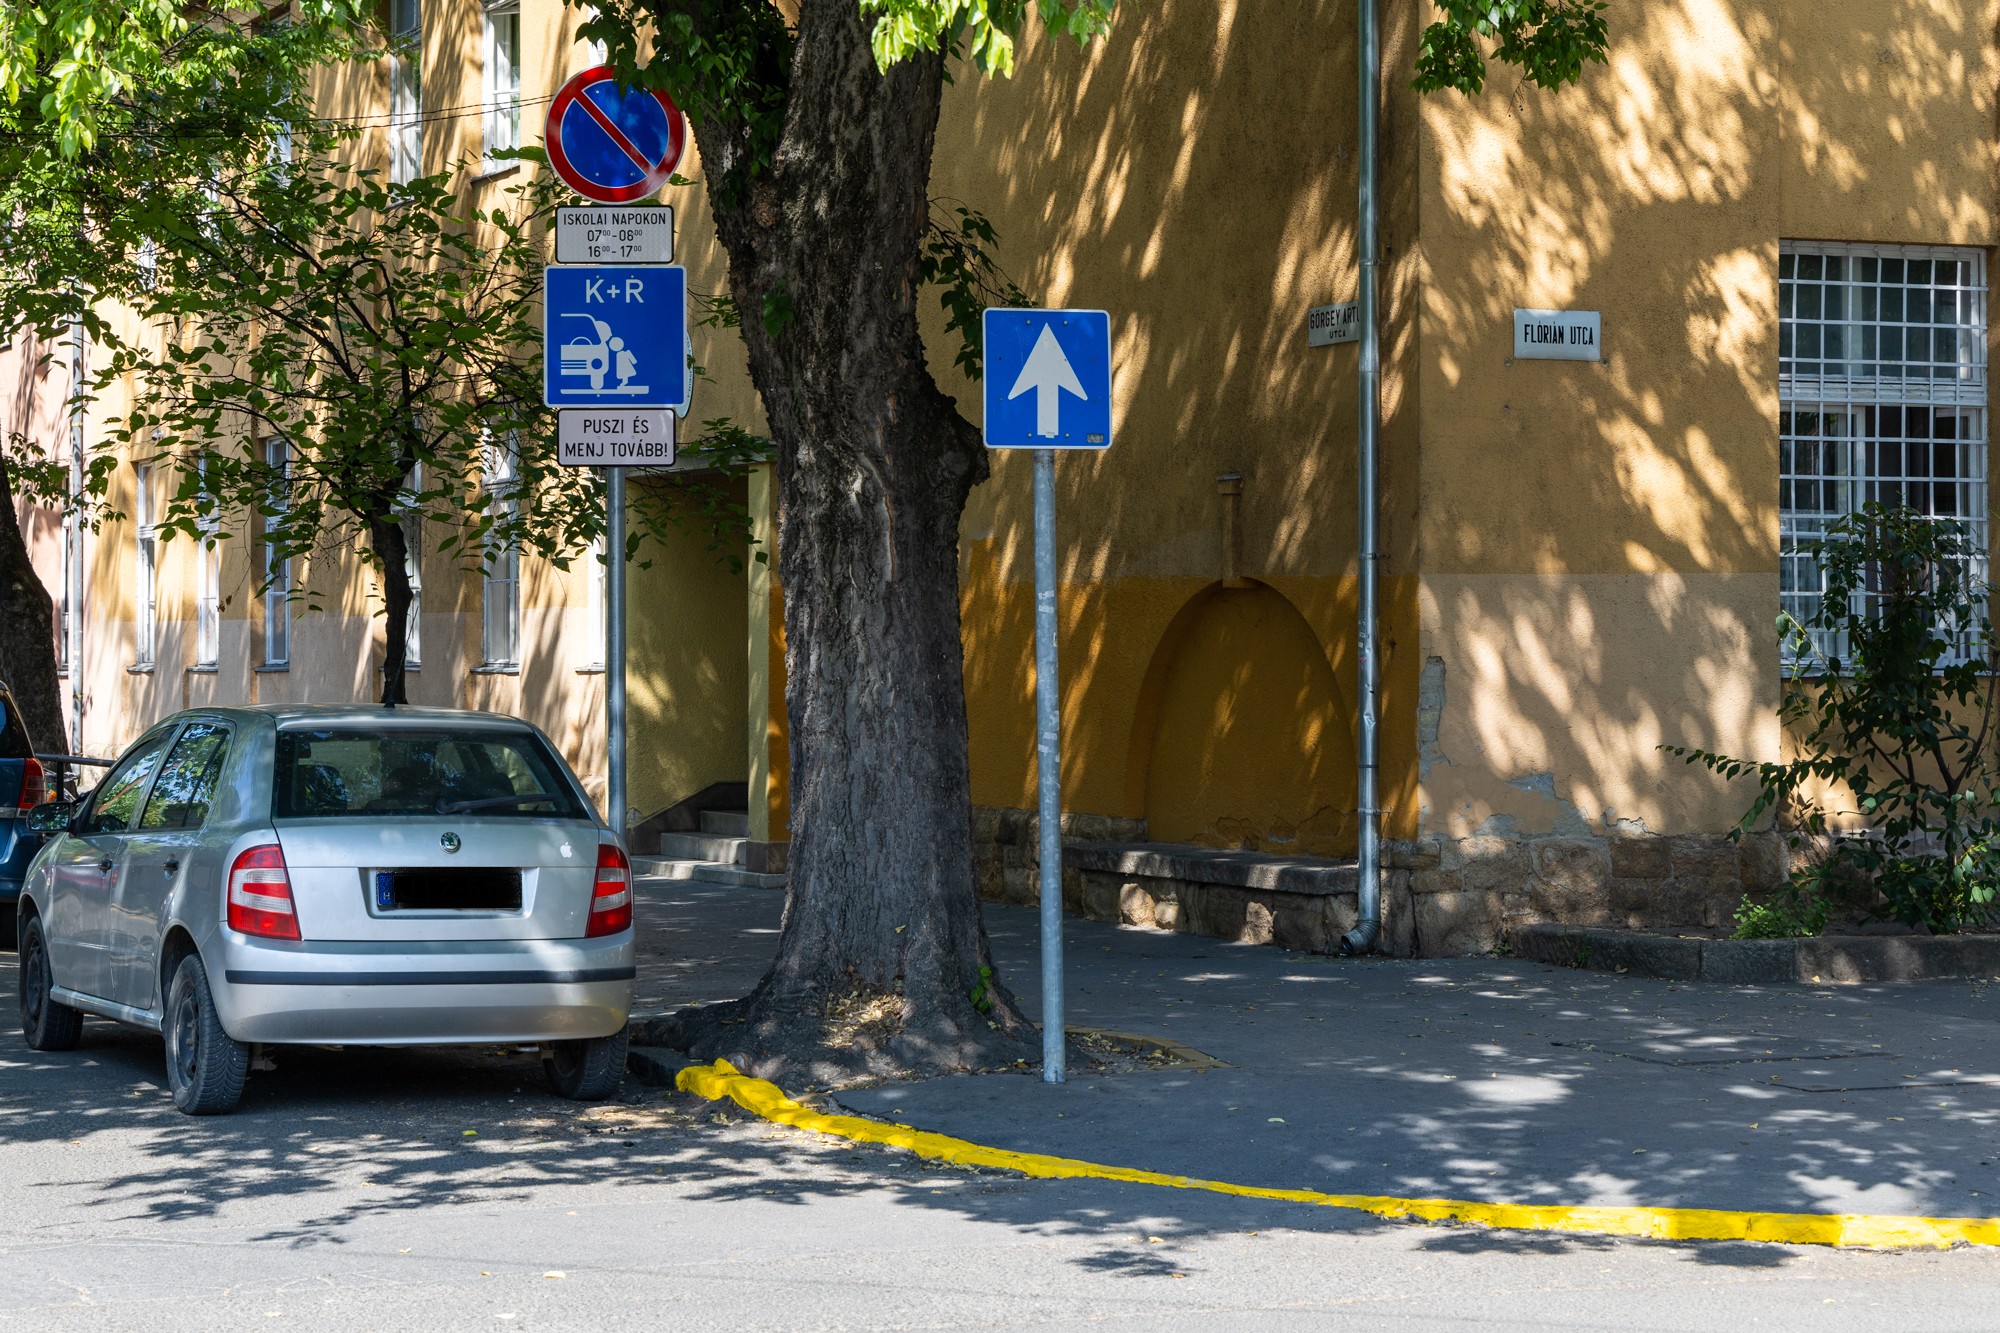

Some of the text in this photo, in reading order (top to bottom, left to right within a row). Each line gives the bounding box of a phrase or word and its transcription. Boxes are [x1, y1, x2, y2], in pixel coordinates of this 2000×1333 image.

[563, 212, 666, 226] ISKOLAI NAPOKON
[585, 279, 644, 304] K+R
[1310, 309, 1341, 330] GÖRGEY
[1329, 329, 1347, 339] UTCA
[1524, 320, 1594, 346] FLÓRIÁN UTCA
[583, 415, 649, 434] PUSZI ÉS
[565, 438, 668, 457] MENJ TOVÁBB!
